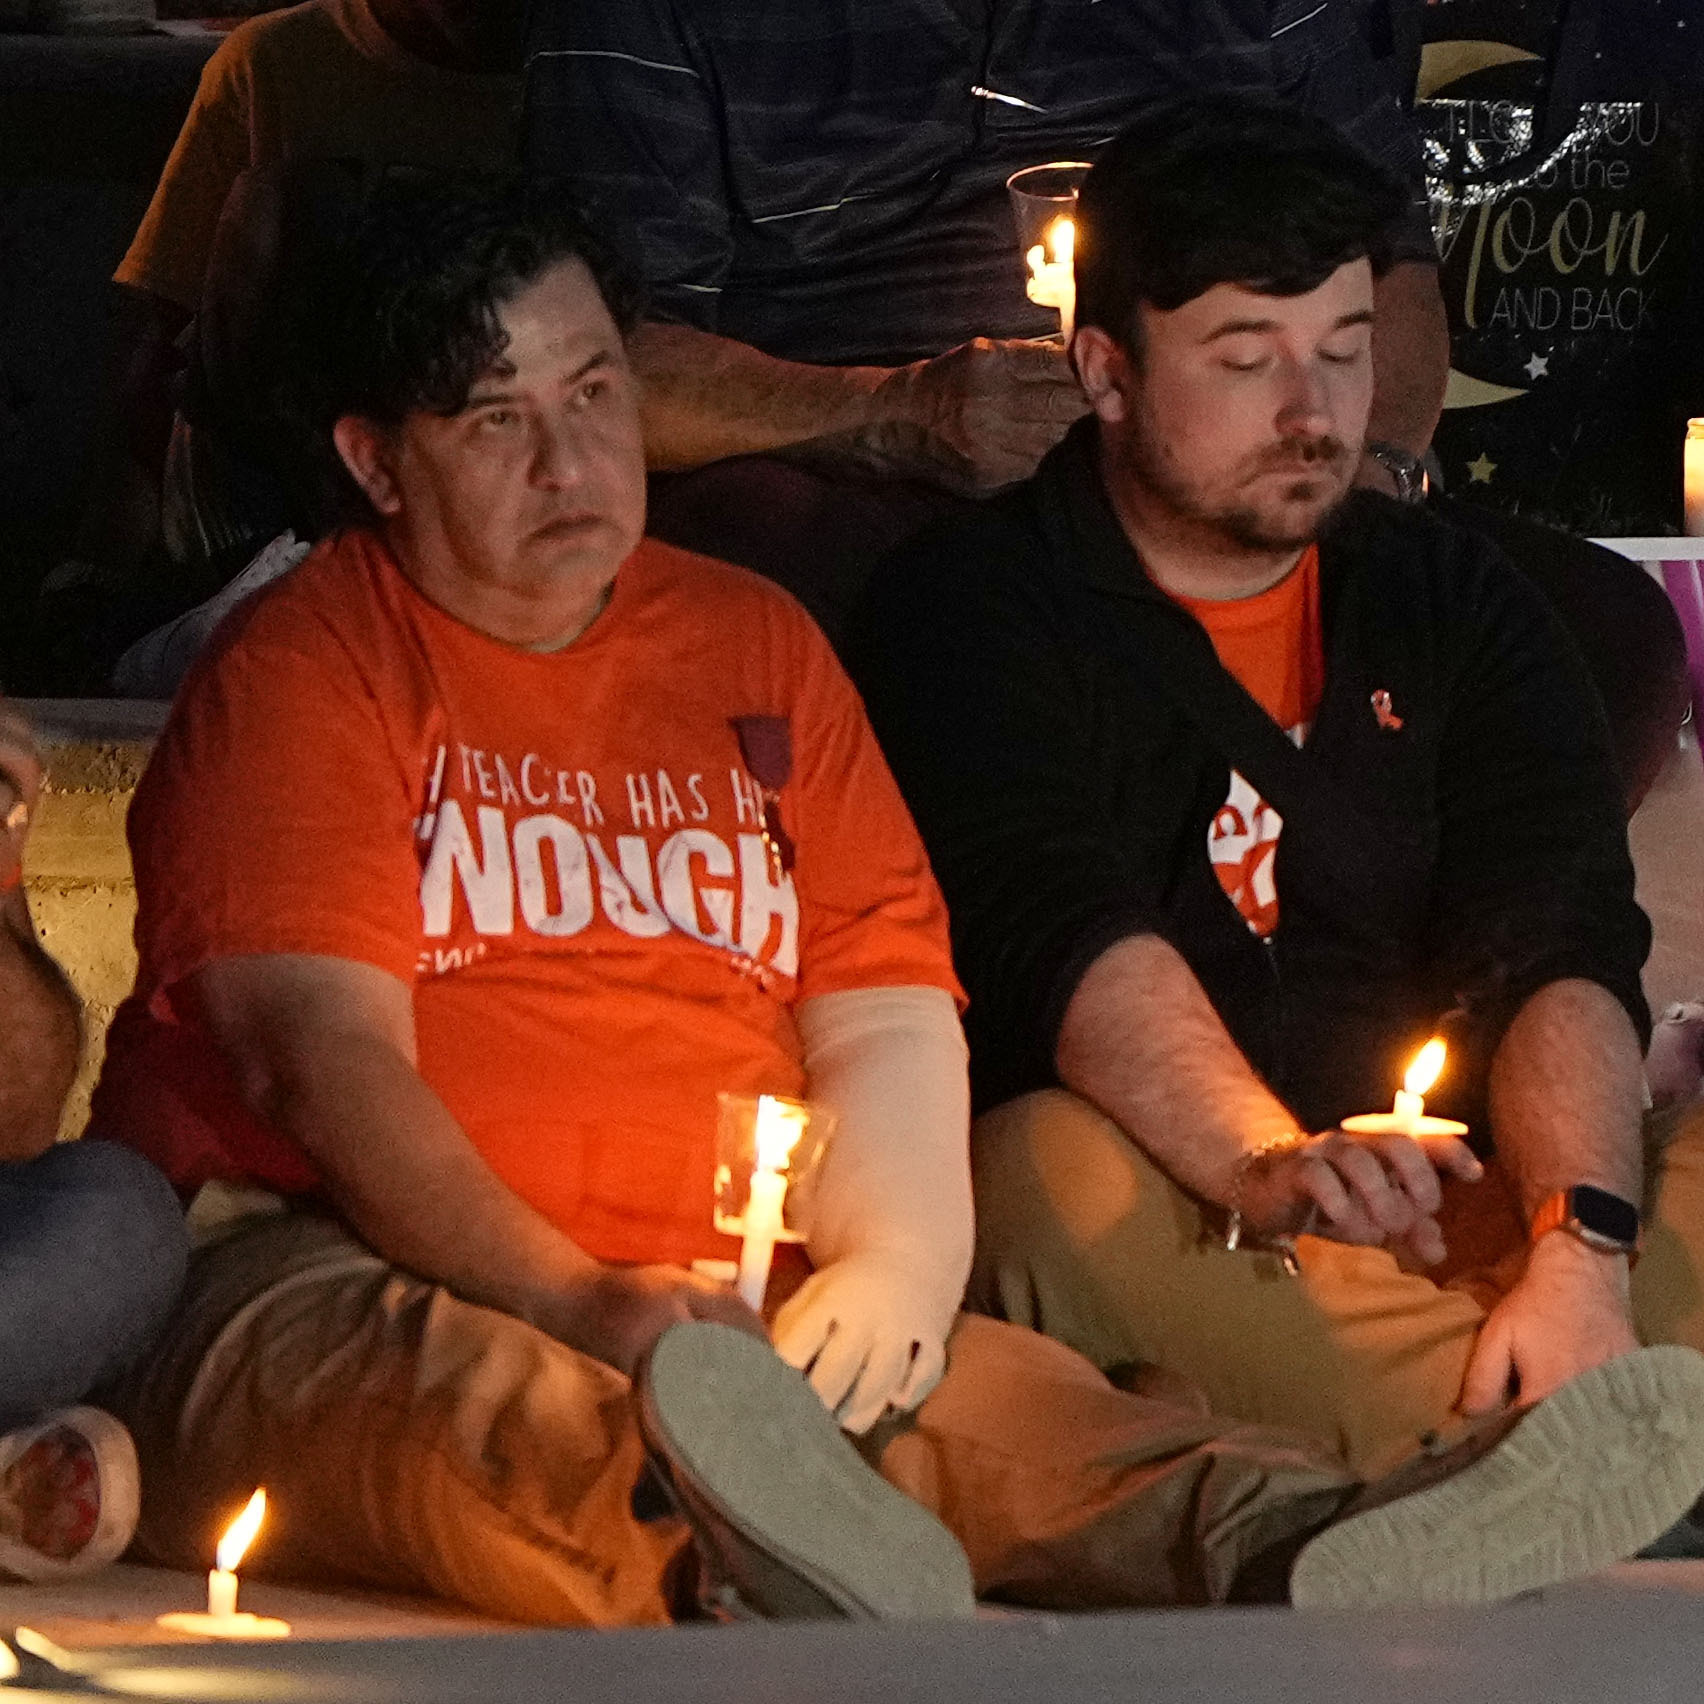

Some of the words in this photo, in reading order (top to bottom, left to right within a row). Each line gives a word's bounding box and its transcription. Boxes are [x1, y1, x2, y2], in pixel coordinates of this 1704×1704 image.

[1488, 286, 1562, 331] AND
[457, 741, 605, 827] TEACER
[626, 768, 711, 831] HAS
[414, 798, 800, 979] NOUGH
